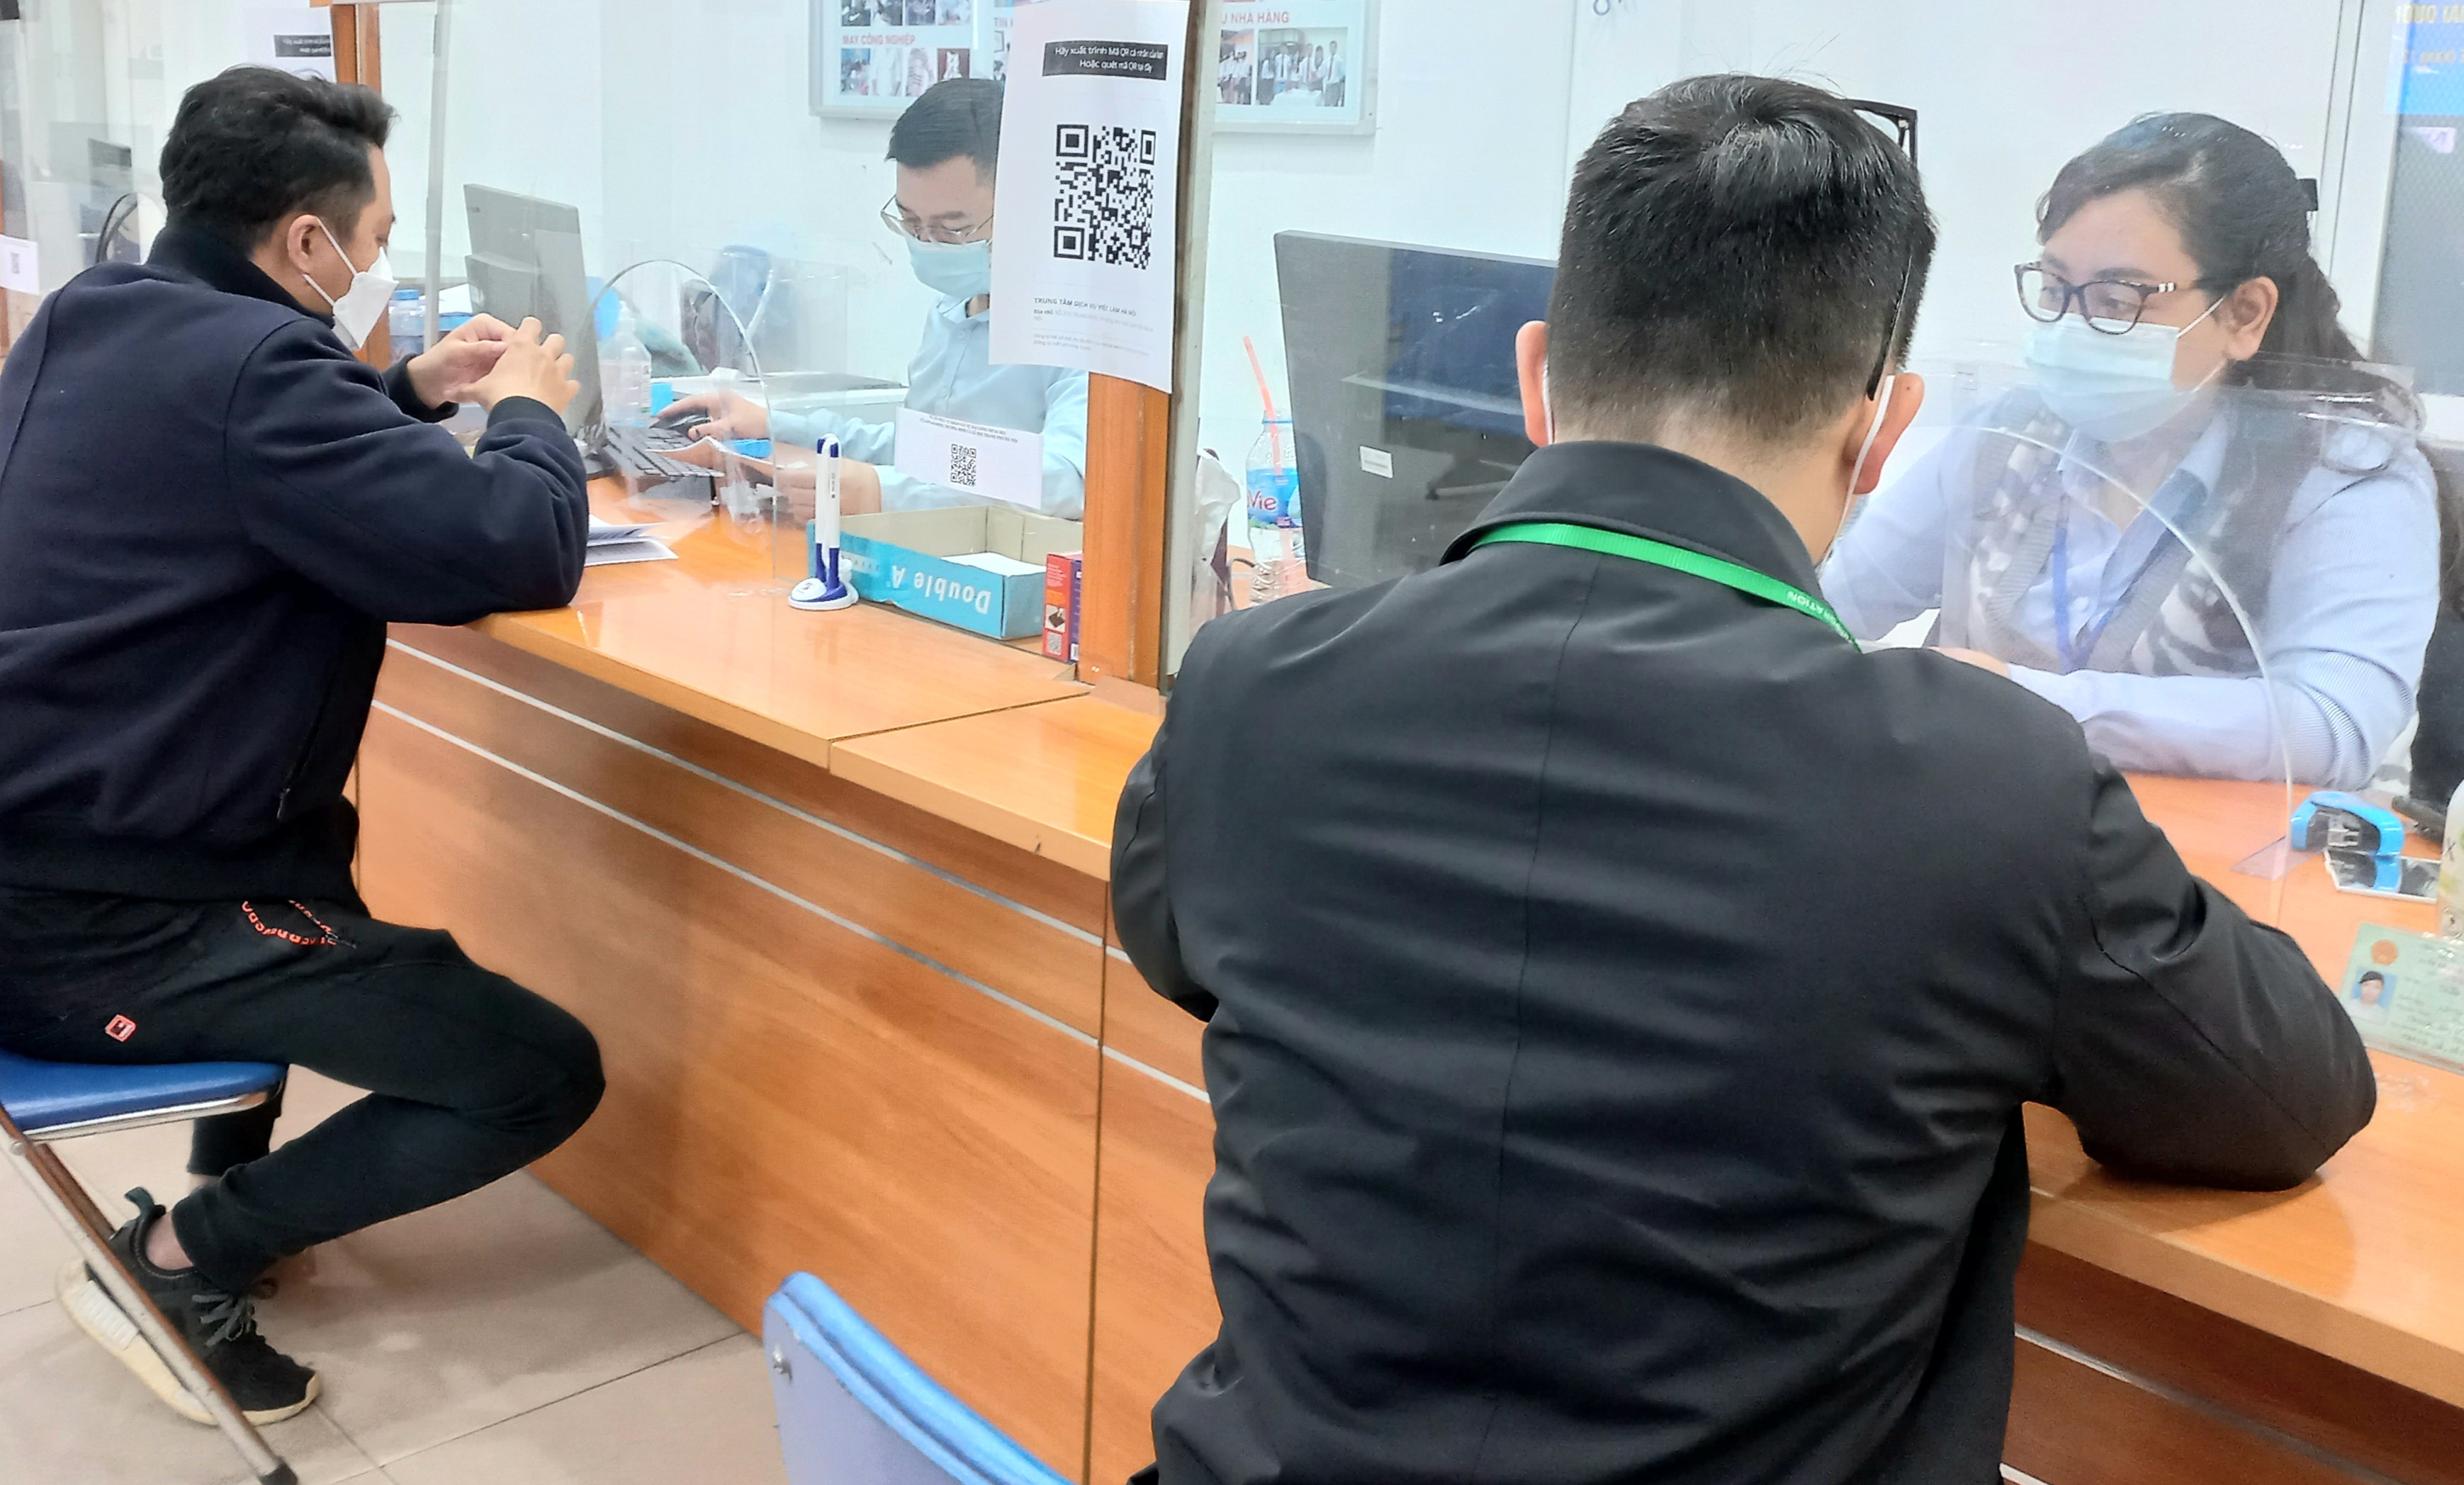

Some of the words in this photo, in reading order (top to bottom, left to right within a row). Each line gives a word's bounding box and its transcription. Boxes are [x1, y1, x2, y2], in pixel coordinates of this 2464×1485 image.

[1231, 8, 1253, 23] NHÀ
[1257, 8, 1289, 23] HÀNG
[843, 34, 858, 45] MAY
[861, 33, 883, 45] CÔNG
[885, 32, 916, 46] NGHIỆP
[1054, 46, 1069, 57] Hãy
[1088, 45, 1108, 55] trình
[1120, 47, 1130, 57] QR
[1079, 59, 1100, 69] Hoặc
[1059, 298, 1073, 306] TÂM
[891, 565, 906, 590] A
[913, 571, 991, 615] Double
